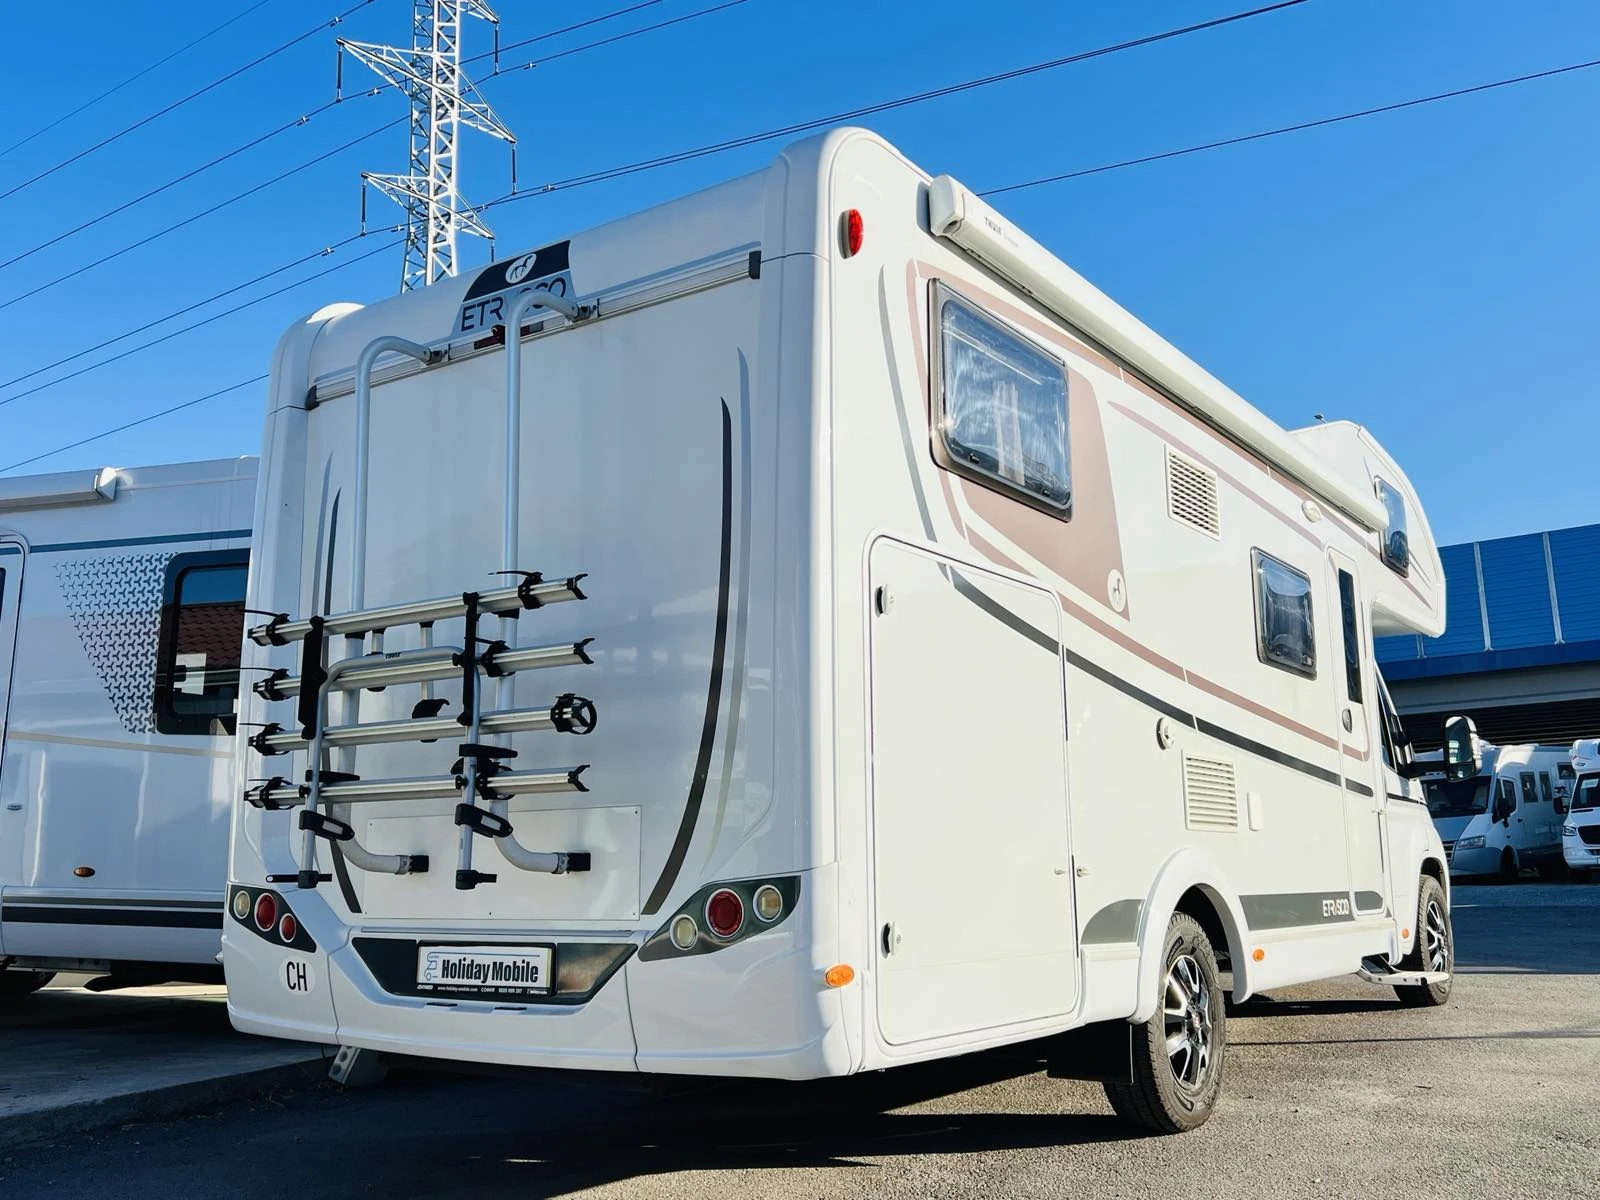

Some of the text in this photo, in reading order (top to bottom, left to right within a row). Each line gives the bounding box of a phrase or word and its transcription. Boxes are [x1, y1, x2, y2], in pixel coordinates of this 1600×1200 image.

[286, 961, 308, 991] CH
[441, 957, 539, 983] Holiday Mobile
